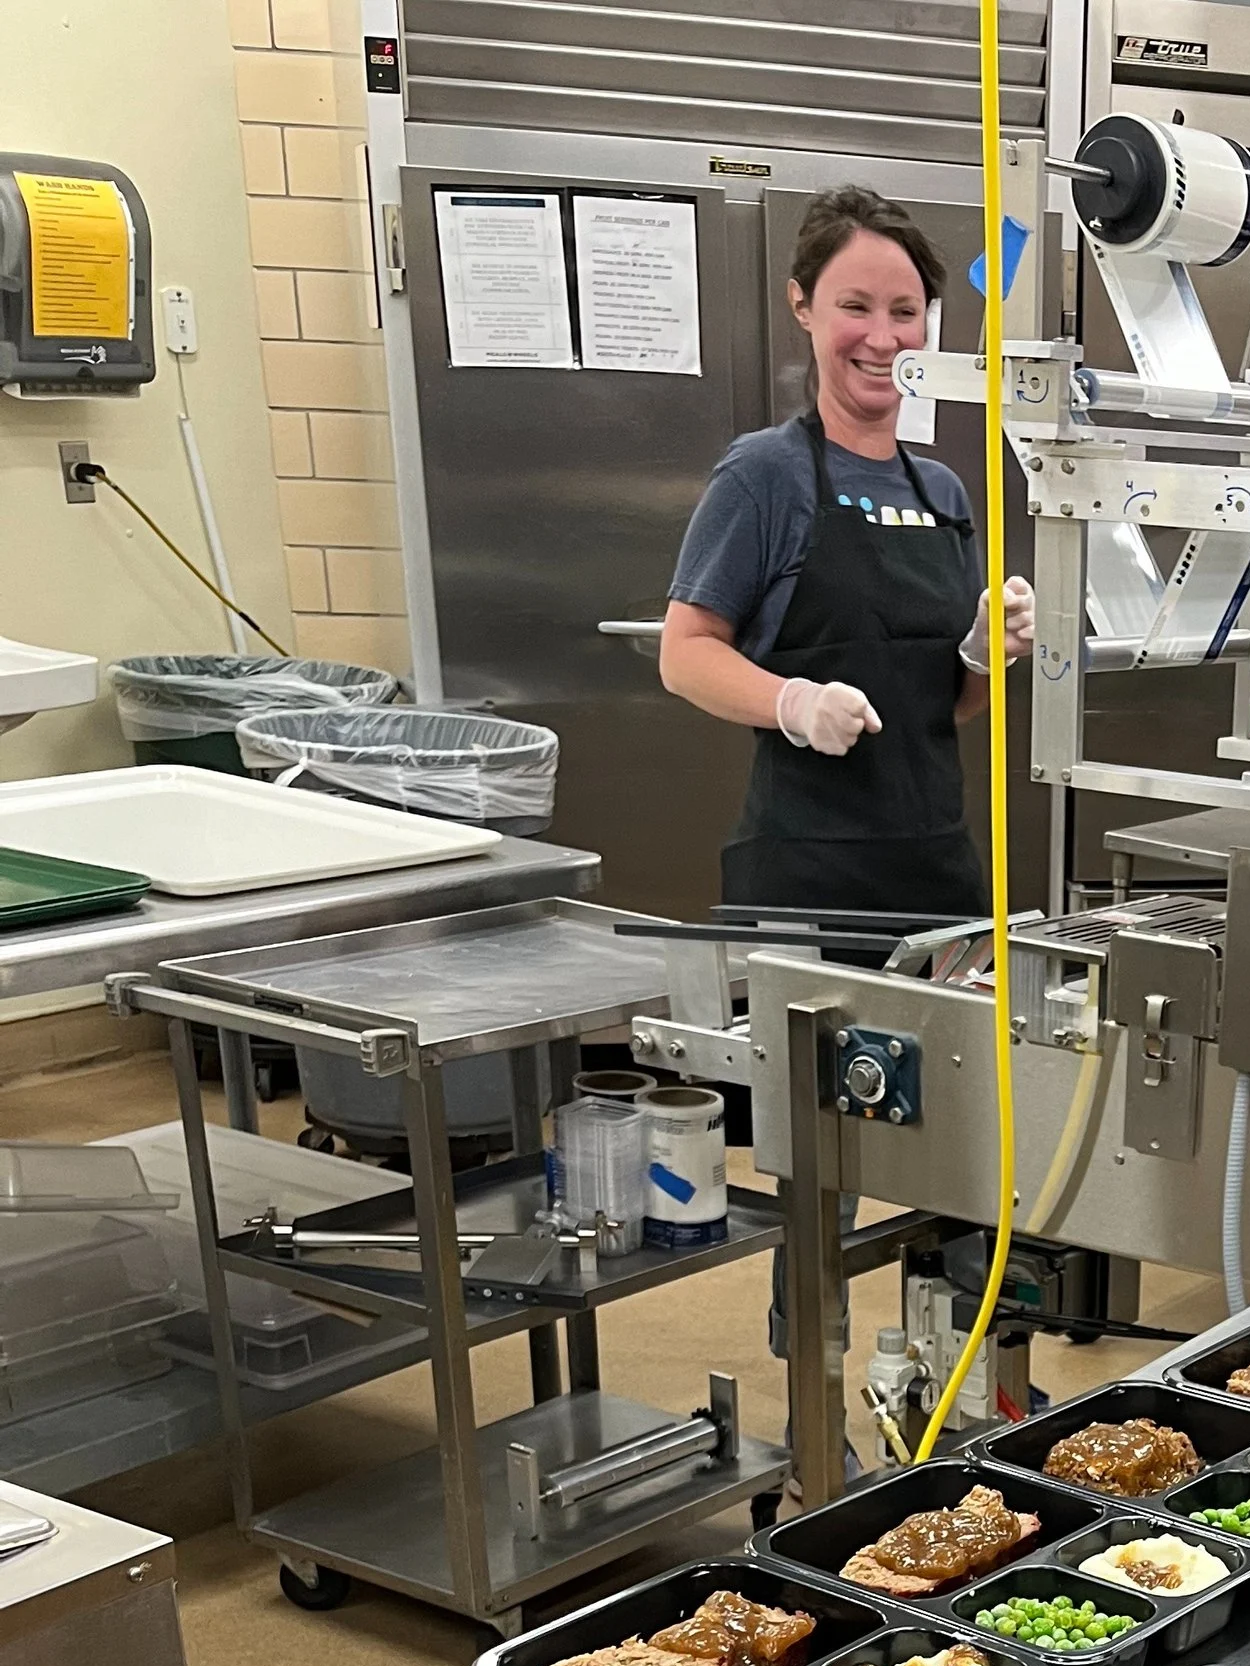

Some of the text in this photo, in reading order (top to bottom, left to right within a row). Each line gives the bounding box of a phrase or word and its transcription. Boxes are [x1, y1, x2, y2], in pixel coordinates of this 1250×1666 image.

[1149, 40, 1206, 57] true
[916, 368, 924, 381] 2
[1018, 369, 1026, 384] 1
[1126, 480, 1133, 491] 4
[1226, 494, 1233, 506] 5
[1040, 644, 1047, 659] 3
